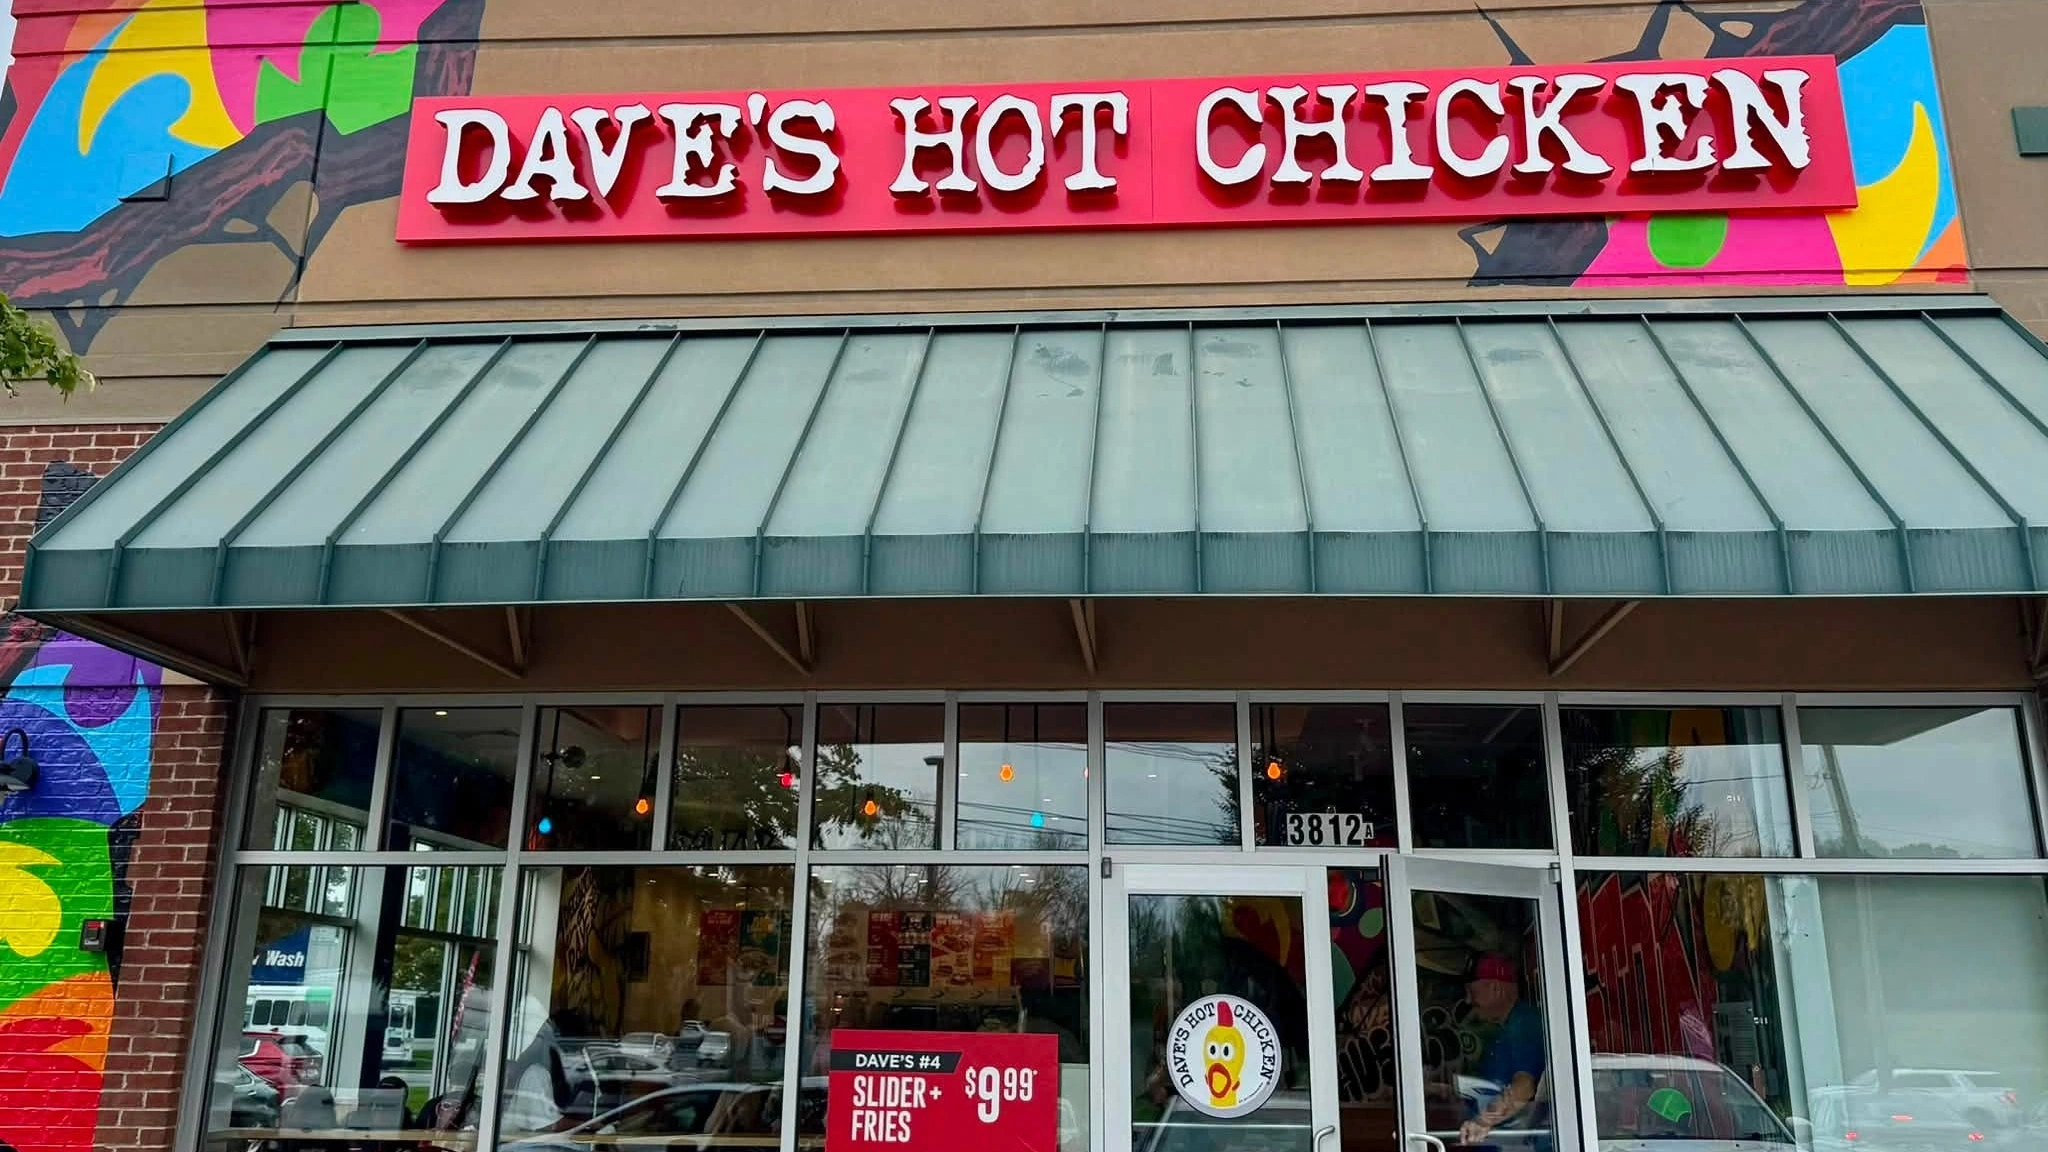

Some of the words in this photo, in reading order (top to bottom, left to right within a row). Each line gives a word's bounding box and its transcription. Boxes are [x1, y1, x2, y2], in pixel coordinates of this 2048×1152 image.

[426, 92, 842, 203] DAVE'S
[889, 91, 1128, 194] HOT
[1196, 68, 1811, 186] CHICKEN
[265, 950, 305, 967] Wash
[855, 1053, 914, 1068] DAVE'S
[919, 1055, 941, 1069] #4
[1173, 1027, 1194, 1088] DAVE'S
[1184, 1002, 1216, 1029] HOT
[1233, 1004, 1276, 1081] CHICKEN
[851, 1110, 912, 1143] FRIES
